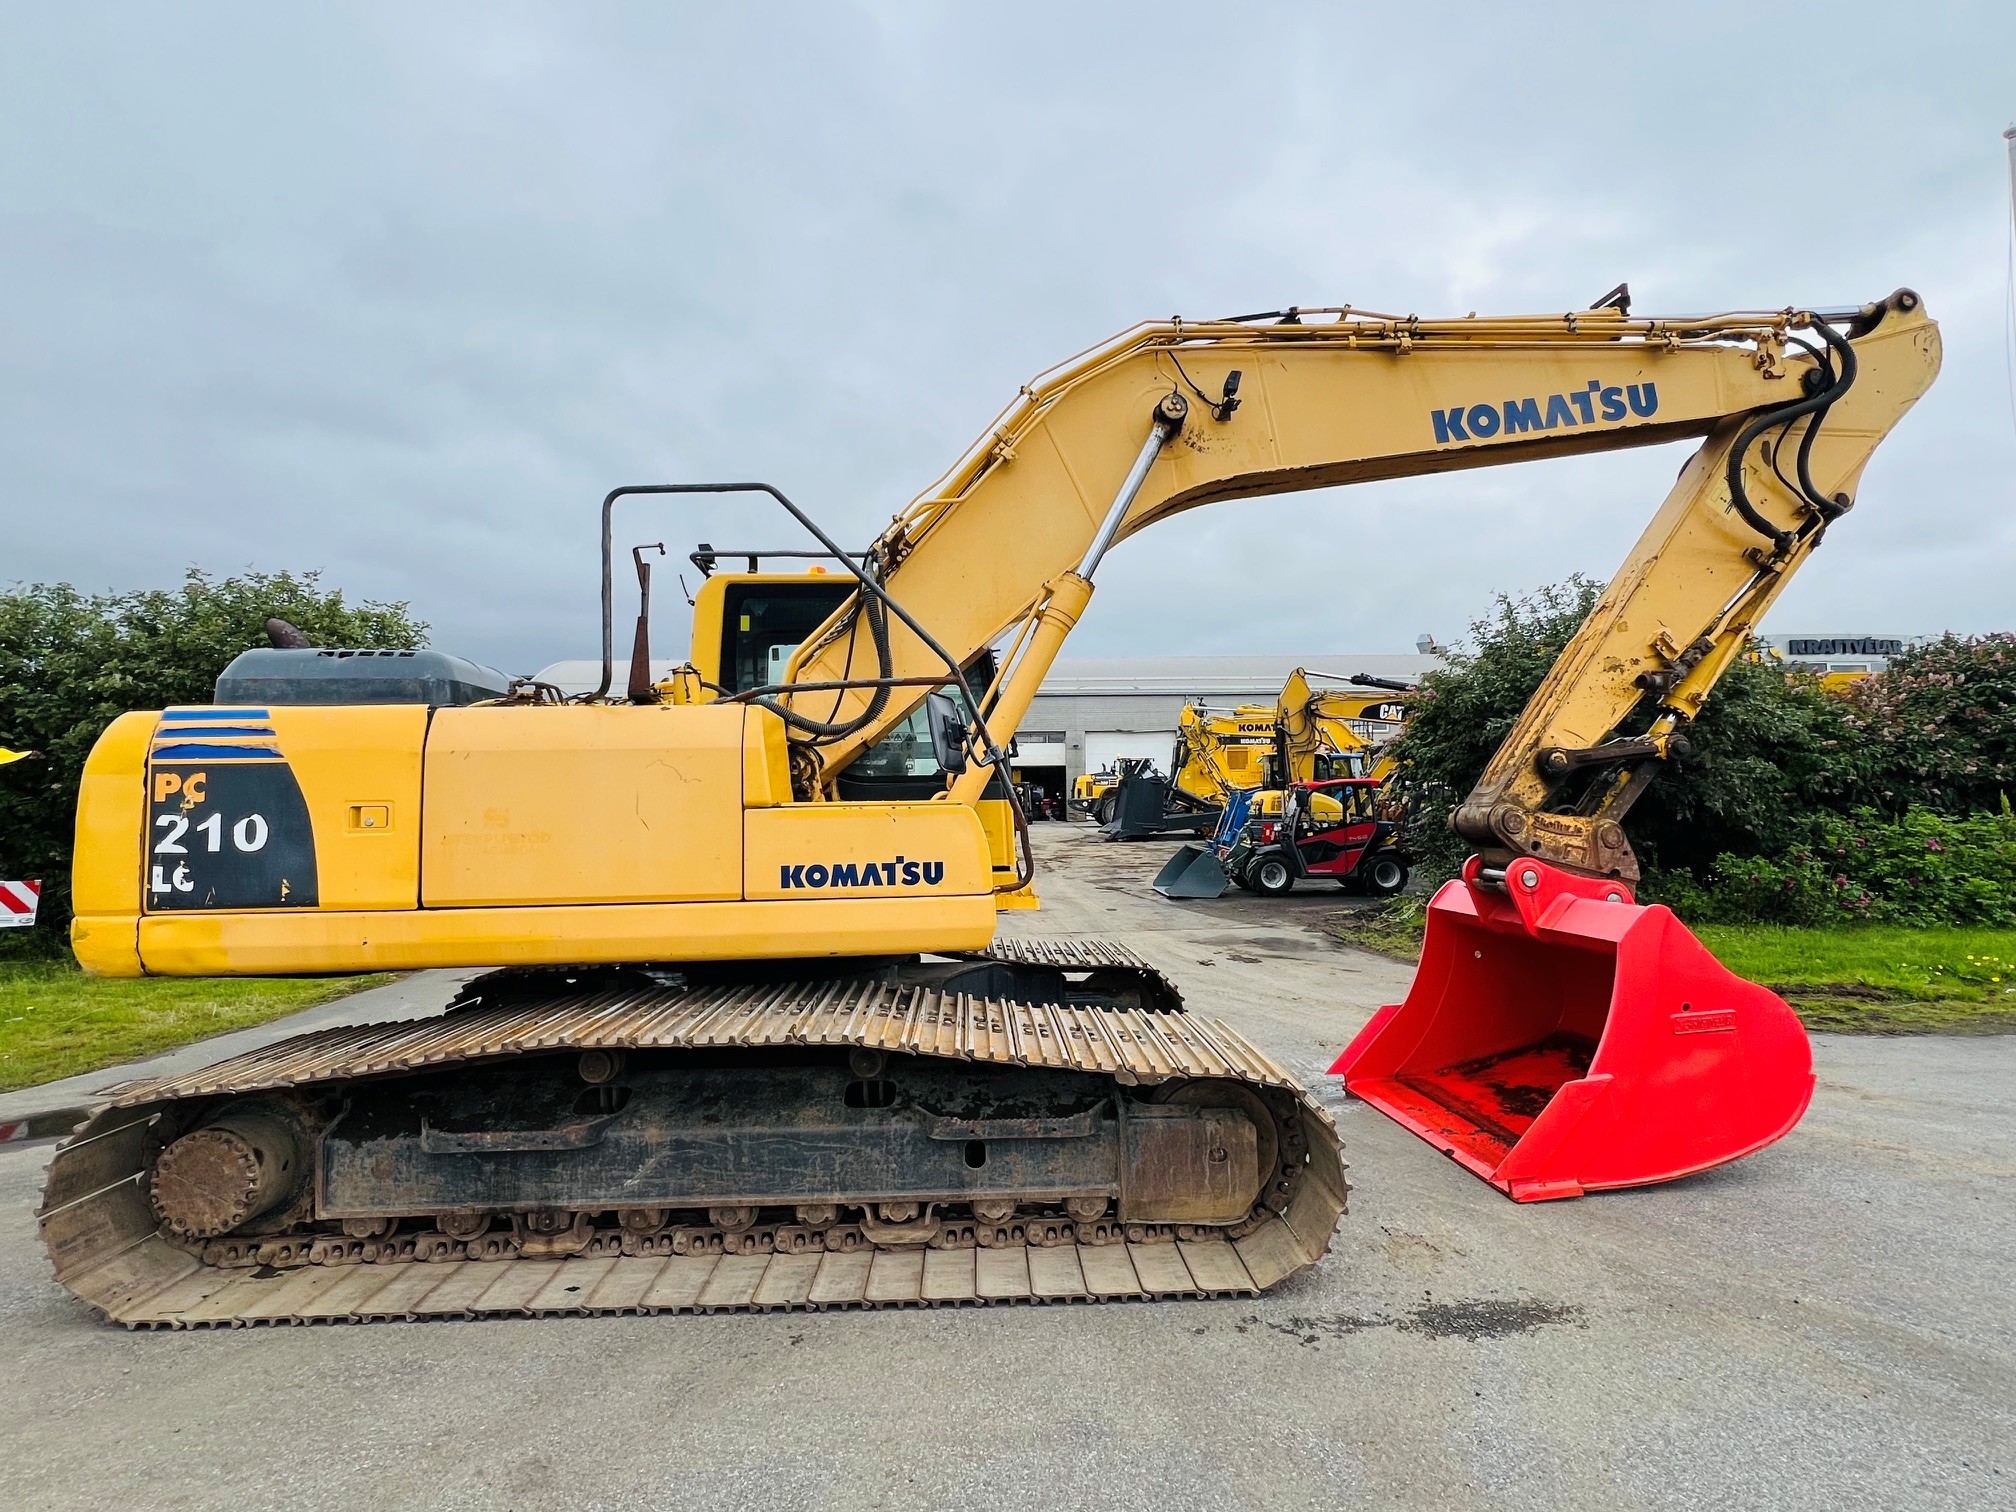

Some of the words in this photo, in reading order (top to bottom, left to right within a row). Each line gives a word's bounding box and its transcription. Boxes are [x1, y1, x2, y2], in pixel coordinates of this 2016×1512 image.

[1431, 380, 1658, 444] KOMATSU
[1238, 724, 1276, 732] KOMAT
[1380, 704, 1405, 720] CAT
[154, 772, 206, 803] PC
[154, 812, 269, 854] 210
[780, 856, 944, 889] KOMATSU
